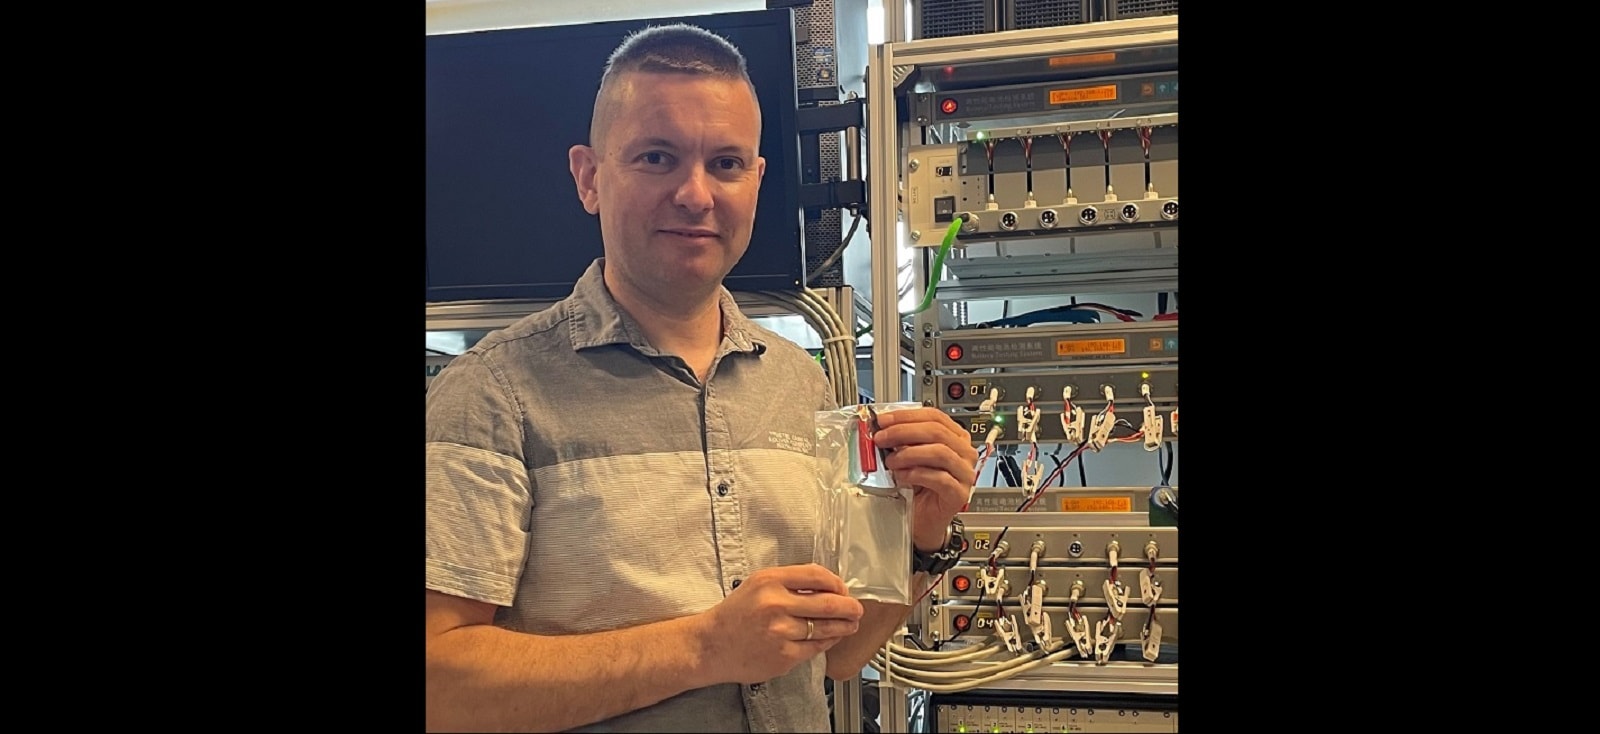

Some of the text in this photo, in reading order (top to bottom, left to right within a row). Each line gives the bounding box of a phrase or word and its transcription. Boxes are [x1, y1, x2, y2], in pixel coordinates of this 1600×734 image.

[970, 385, 987, 396] 01
[970, 423, 987, 433] 05
[974, 539, 990, 550] 02
[977, 617, 994, 628] 04
